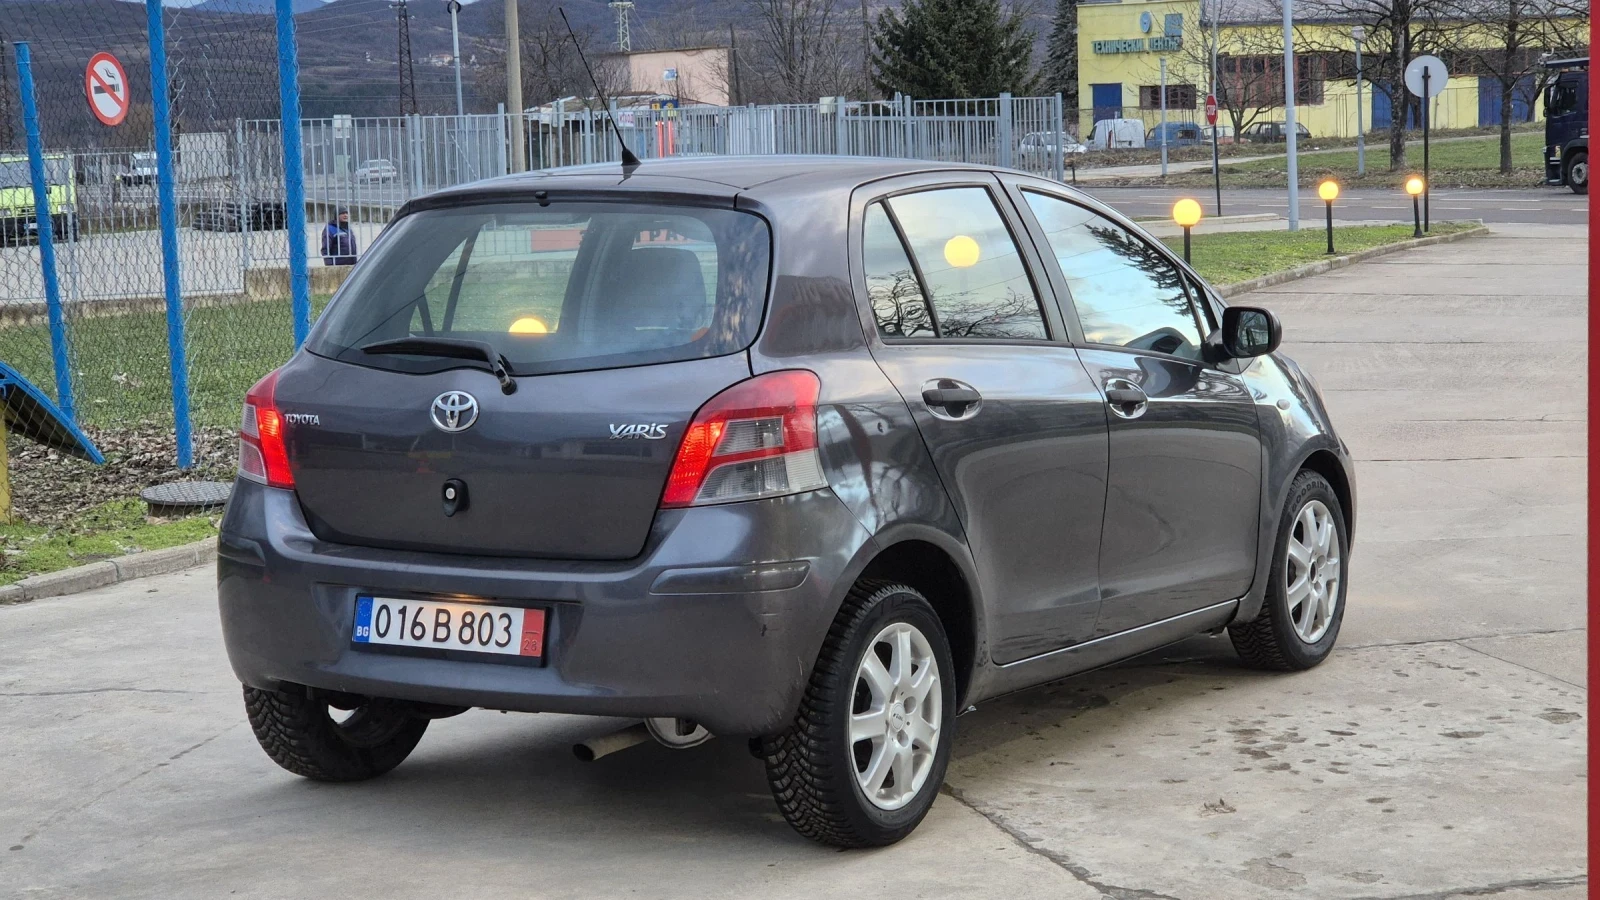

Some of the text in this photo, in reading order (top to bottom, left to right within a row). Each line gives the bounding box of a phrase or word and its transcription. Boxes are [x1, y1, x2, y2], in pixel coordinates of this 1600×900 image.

[1206, 105, 1216, 115] STOP
[284, 413, 320, 425] TOYOTA
[356, 625, 369, 637] BG
